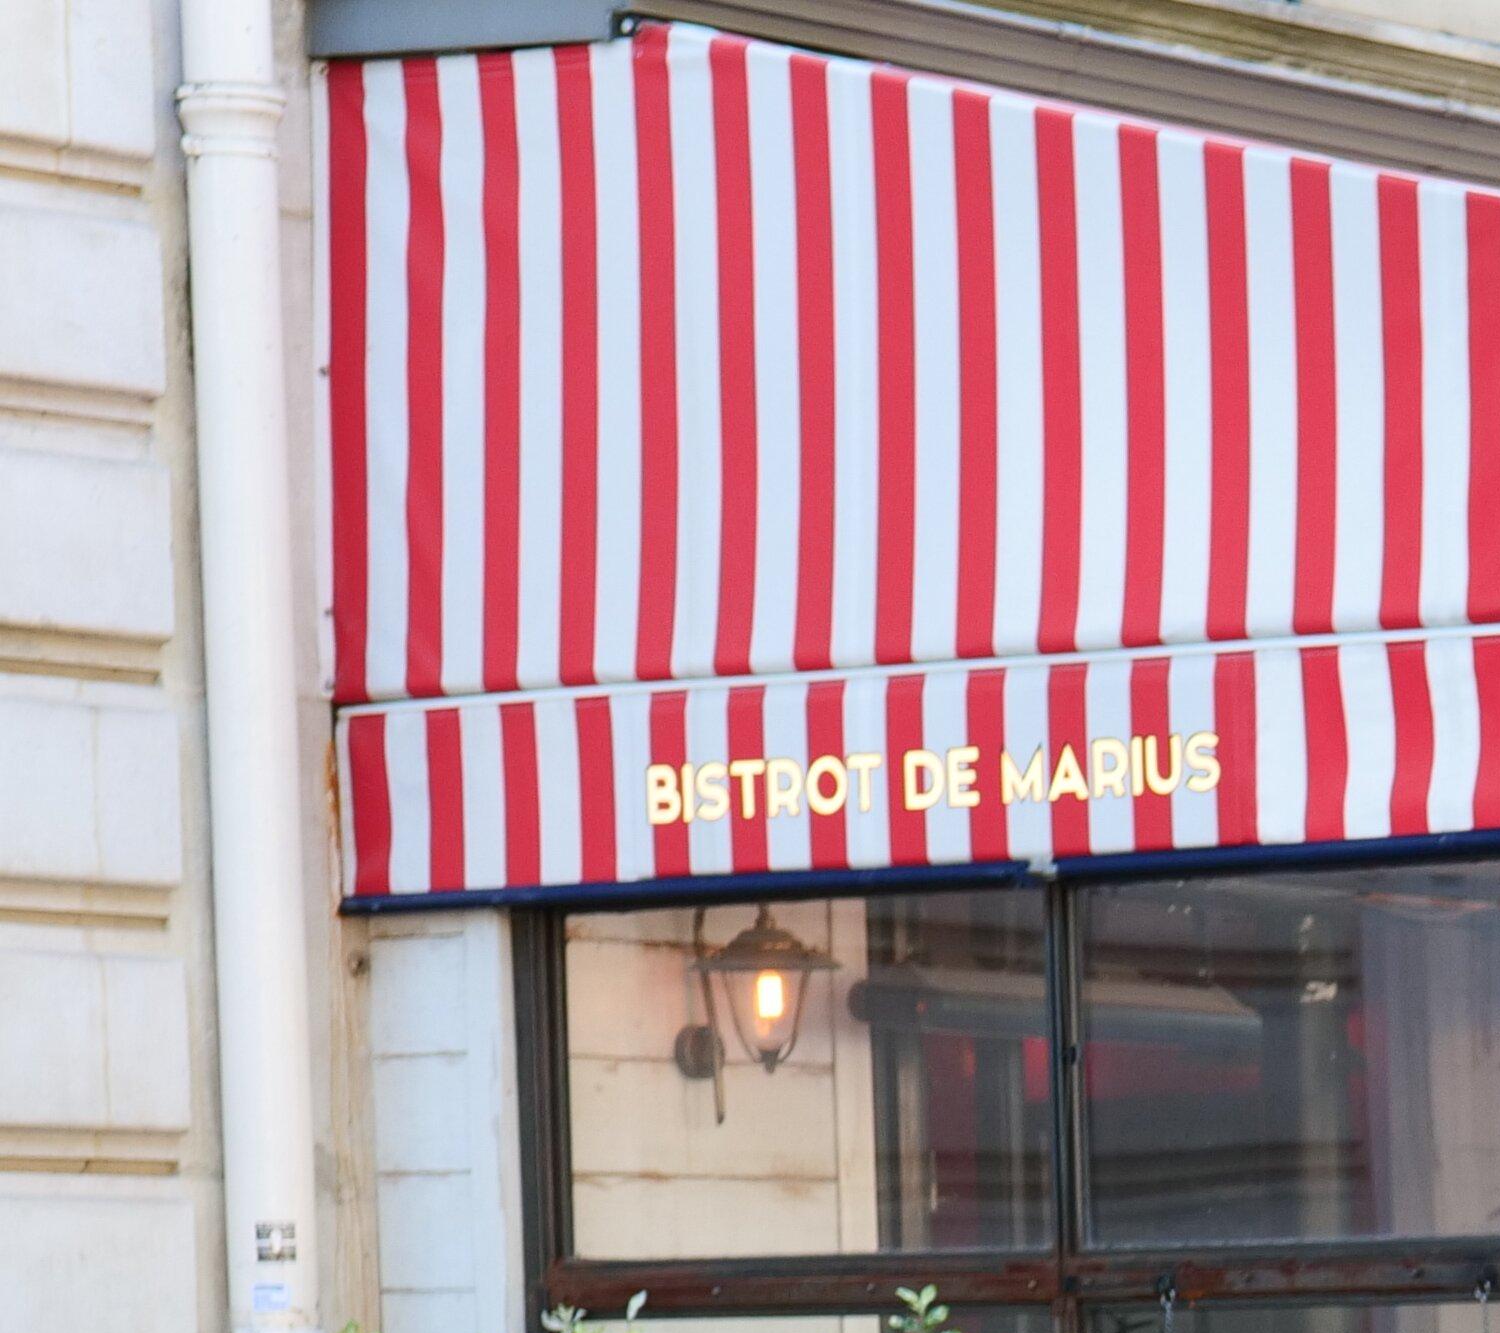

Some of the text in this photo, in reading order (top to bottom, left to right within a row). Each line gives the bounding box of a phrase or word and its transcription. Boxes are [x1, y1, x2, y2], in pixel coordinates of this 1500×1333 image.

[646, 731, 1222, 826] BISTROT DE MARIUS
